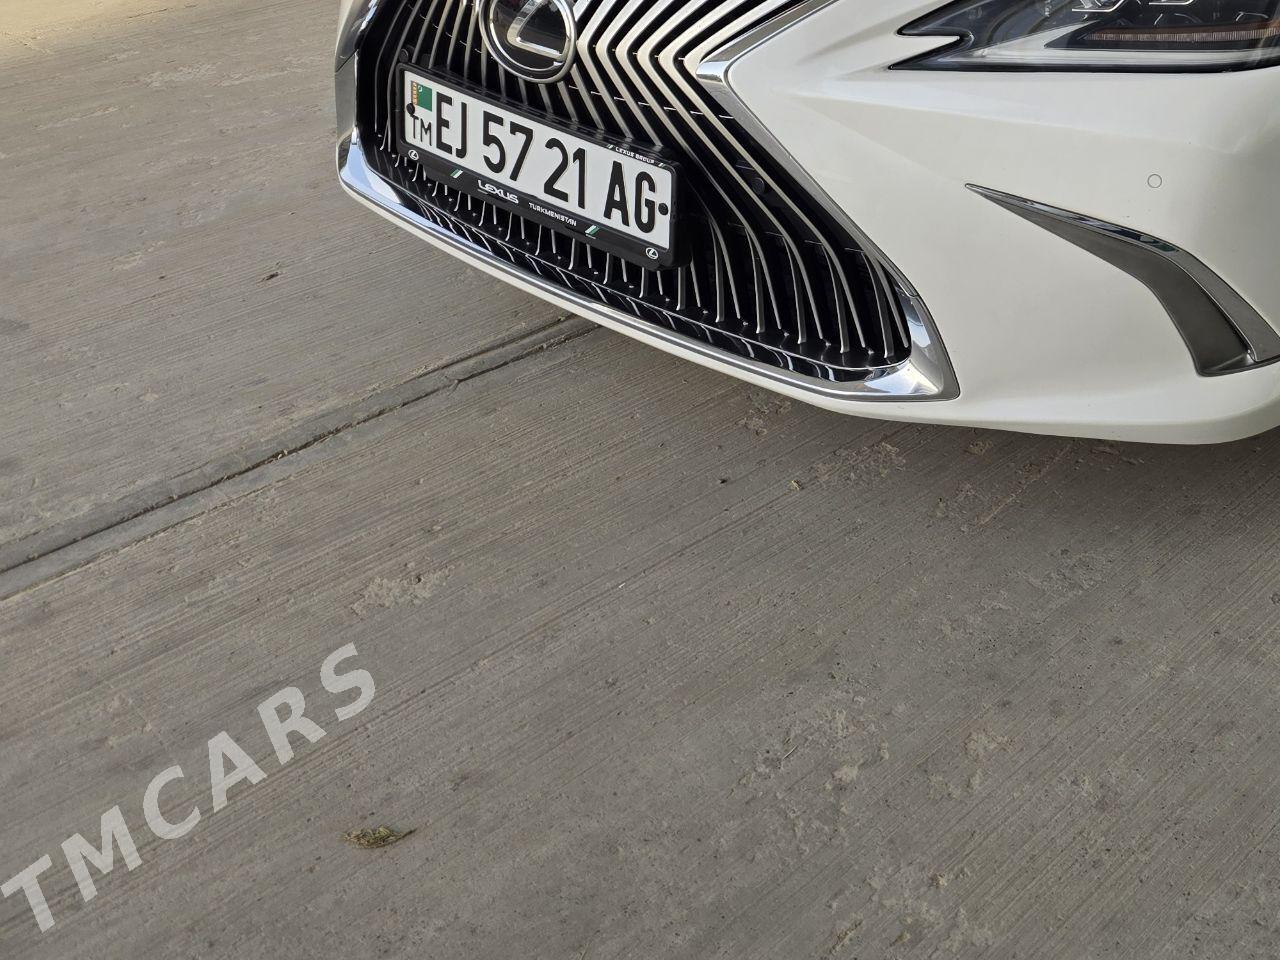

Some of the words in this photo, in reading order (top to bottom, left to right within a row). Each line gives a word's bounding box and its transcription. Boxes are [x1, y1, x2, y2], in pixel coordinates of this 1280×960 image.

[410, 112, 433, 147] TM
[436, 91, 468, 159] EJ
[483, 110, 534, 182] 57
[543, 137, 586, 210] 21
[603, 160, 656, 234] AG
[477, 179, 519, 204] LEXUS
[528, 202, 577, 227] TURKMENISTAN
